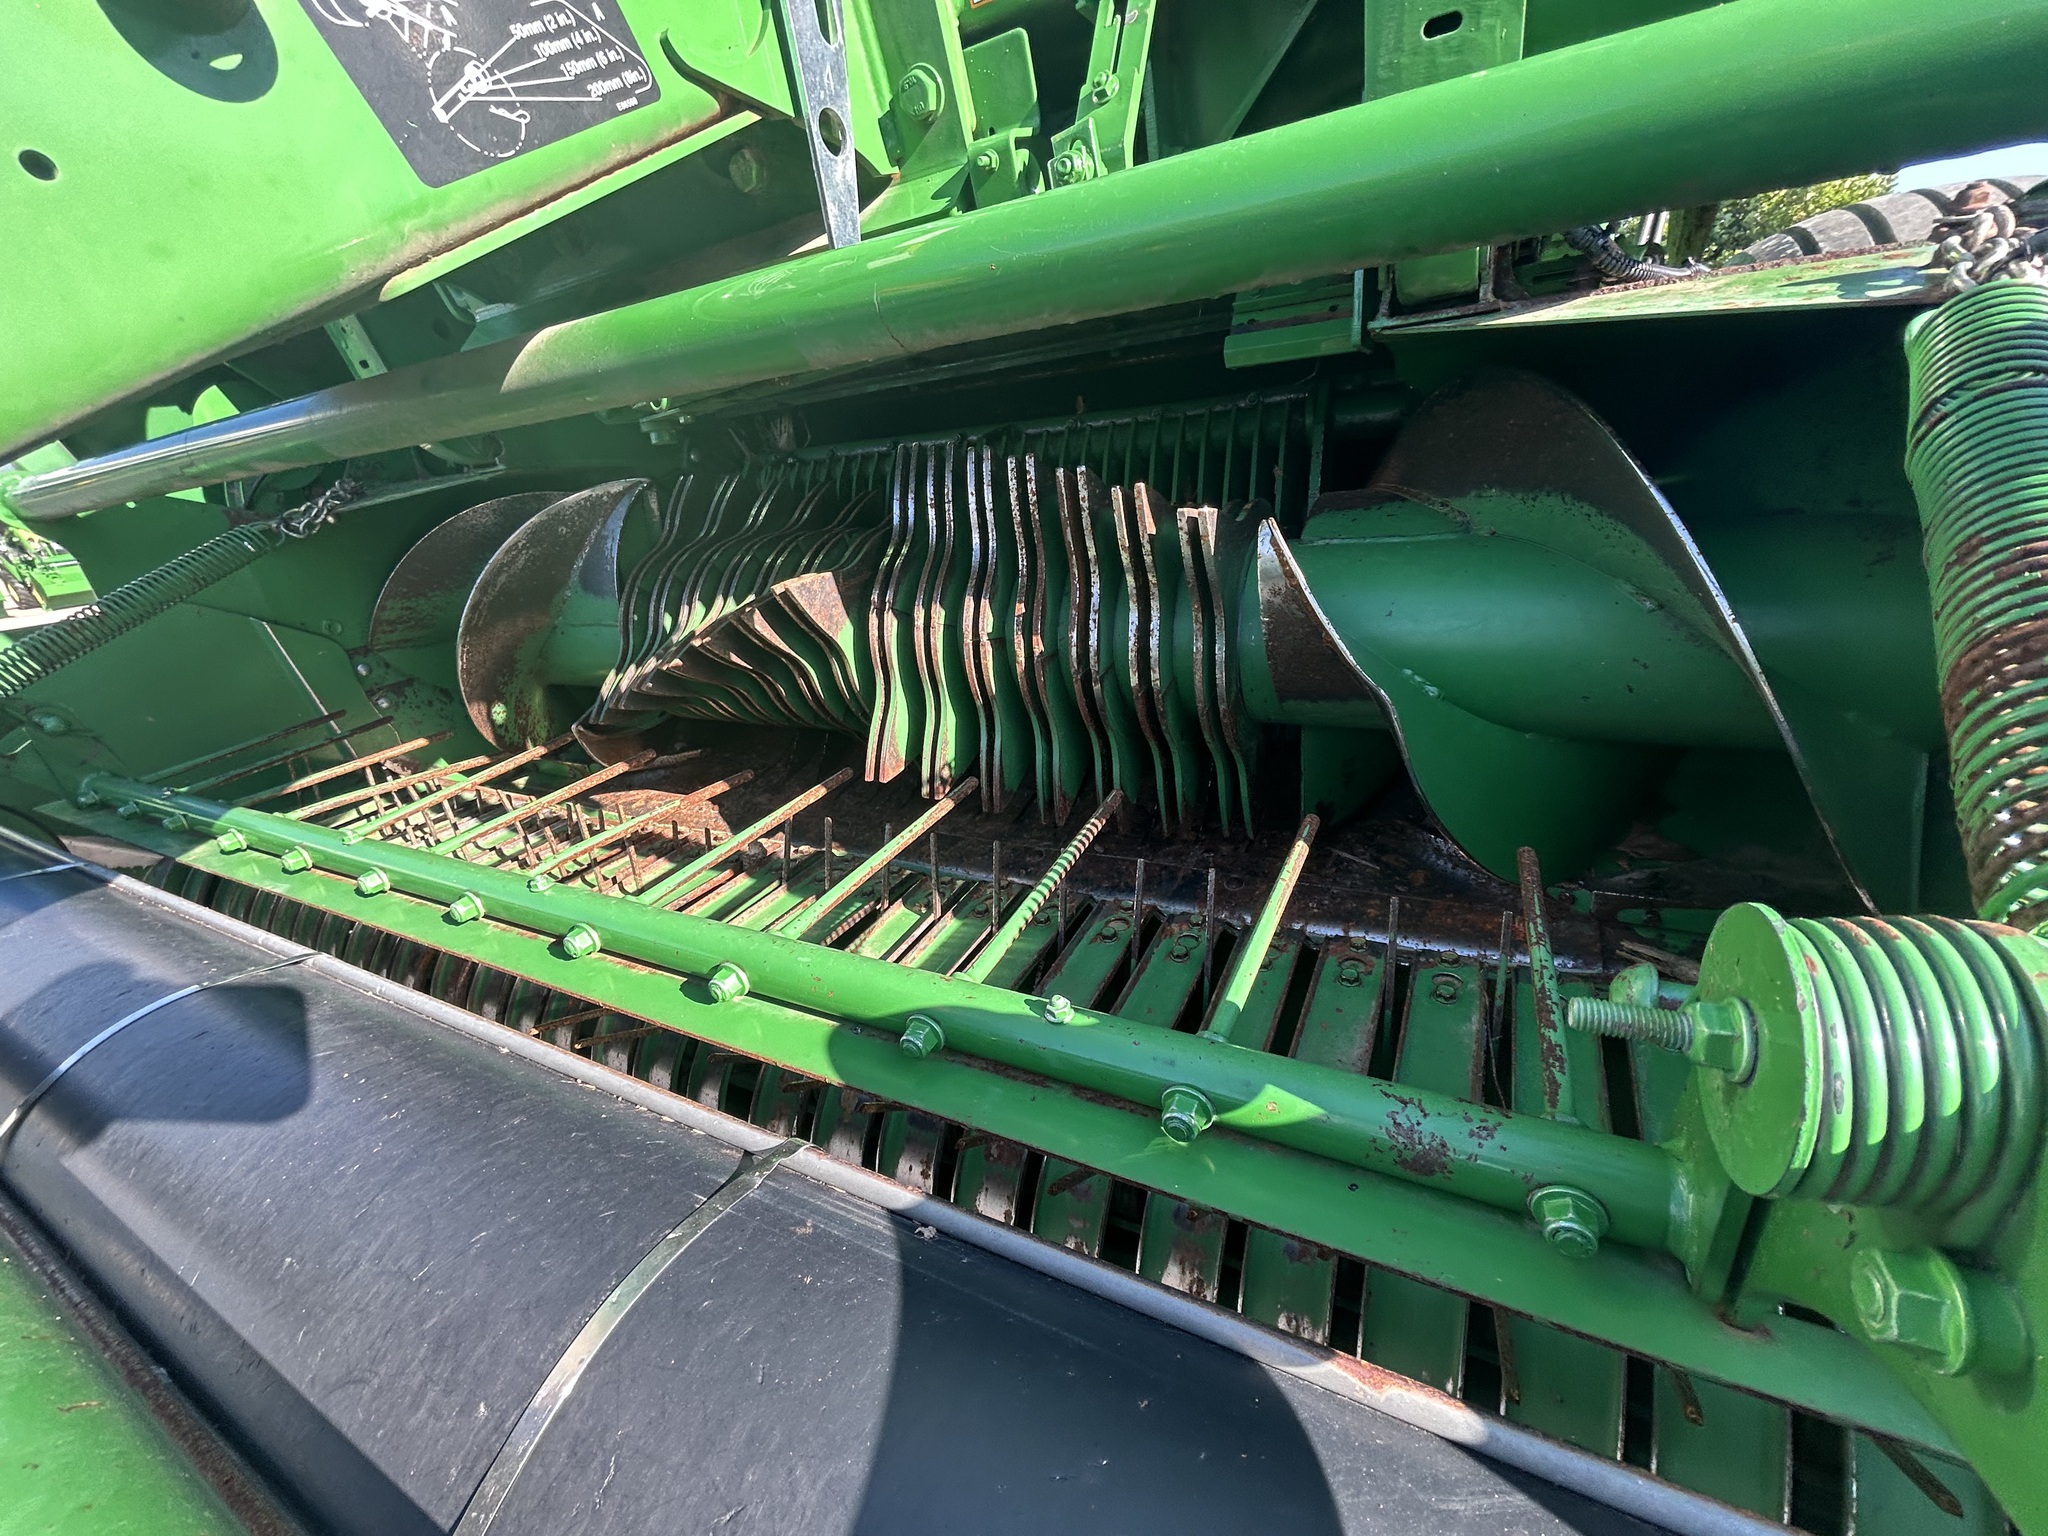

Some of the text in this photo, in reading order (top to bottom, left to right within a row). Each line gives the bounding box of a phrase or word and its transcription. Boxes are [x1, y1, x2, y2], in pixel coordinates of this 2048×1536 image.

[509, 8, 577, 41] 50mm (2 in.)
[592, 2, 606, 21] A
[533, 26, 602, 58] 100mm (4 in.)
[560, 45, 626, 77] 150mm (6 in.)
[587, 77, 624, 98] 200mm
